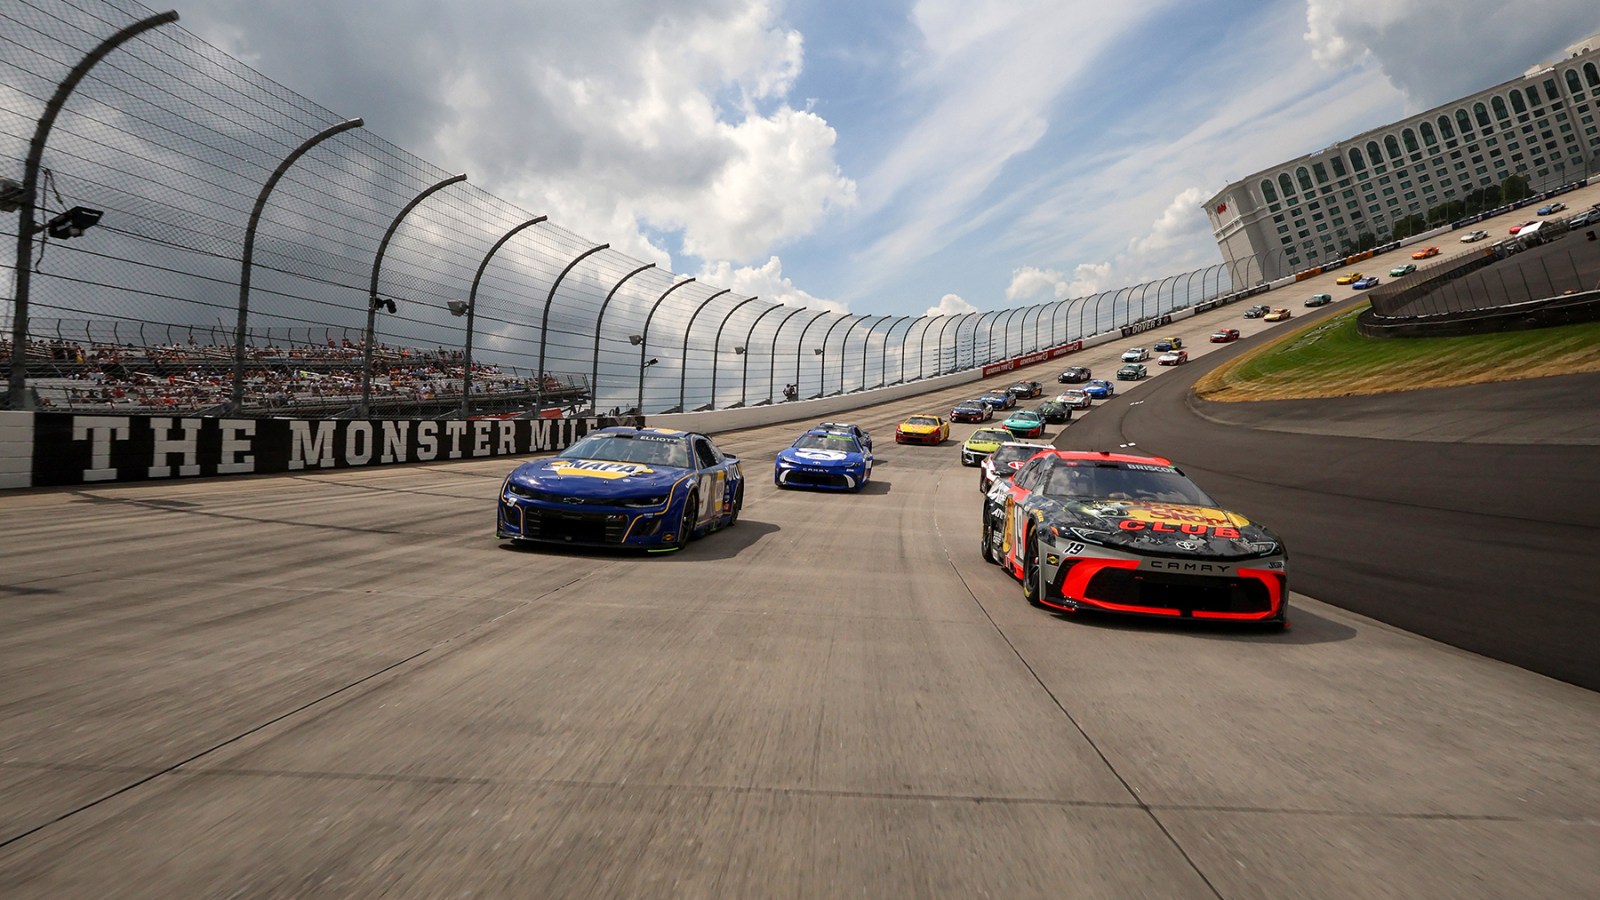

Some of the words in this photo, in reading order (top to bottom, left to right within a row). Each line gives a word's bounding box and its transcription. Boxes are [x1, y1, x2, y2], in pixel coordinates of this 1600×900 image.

[640, 435, 681, 444] ELLIOTT
[72, 415, 256, 482] THE
[288, 420, 517, 470] MONSTER
[570, 460, 638, 474] NAPA
[699, 474, 711, 517] 9
[1118, 519, 1241, 539] CLUB
[1062, 541, 1085, 555] 19
[1151, 560, 1230, 573] CAMRY
